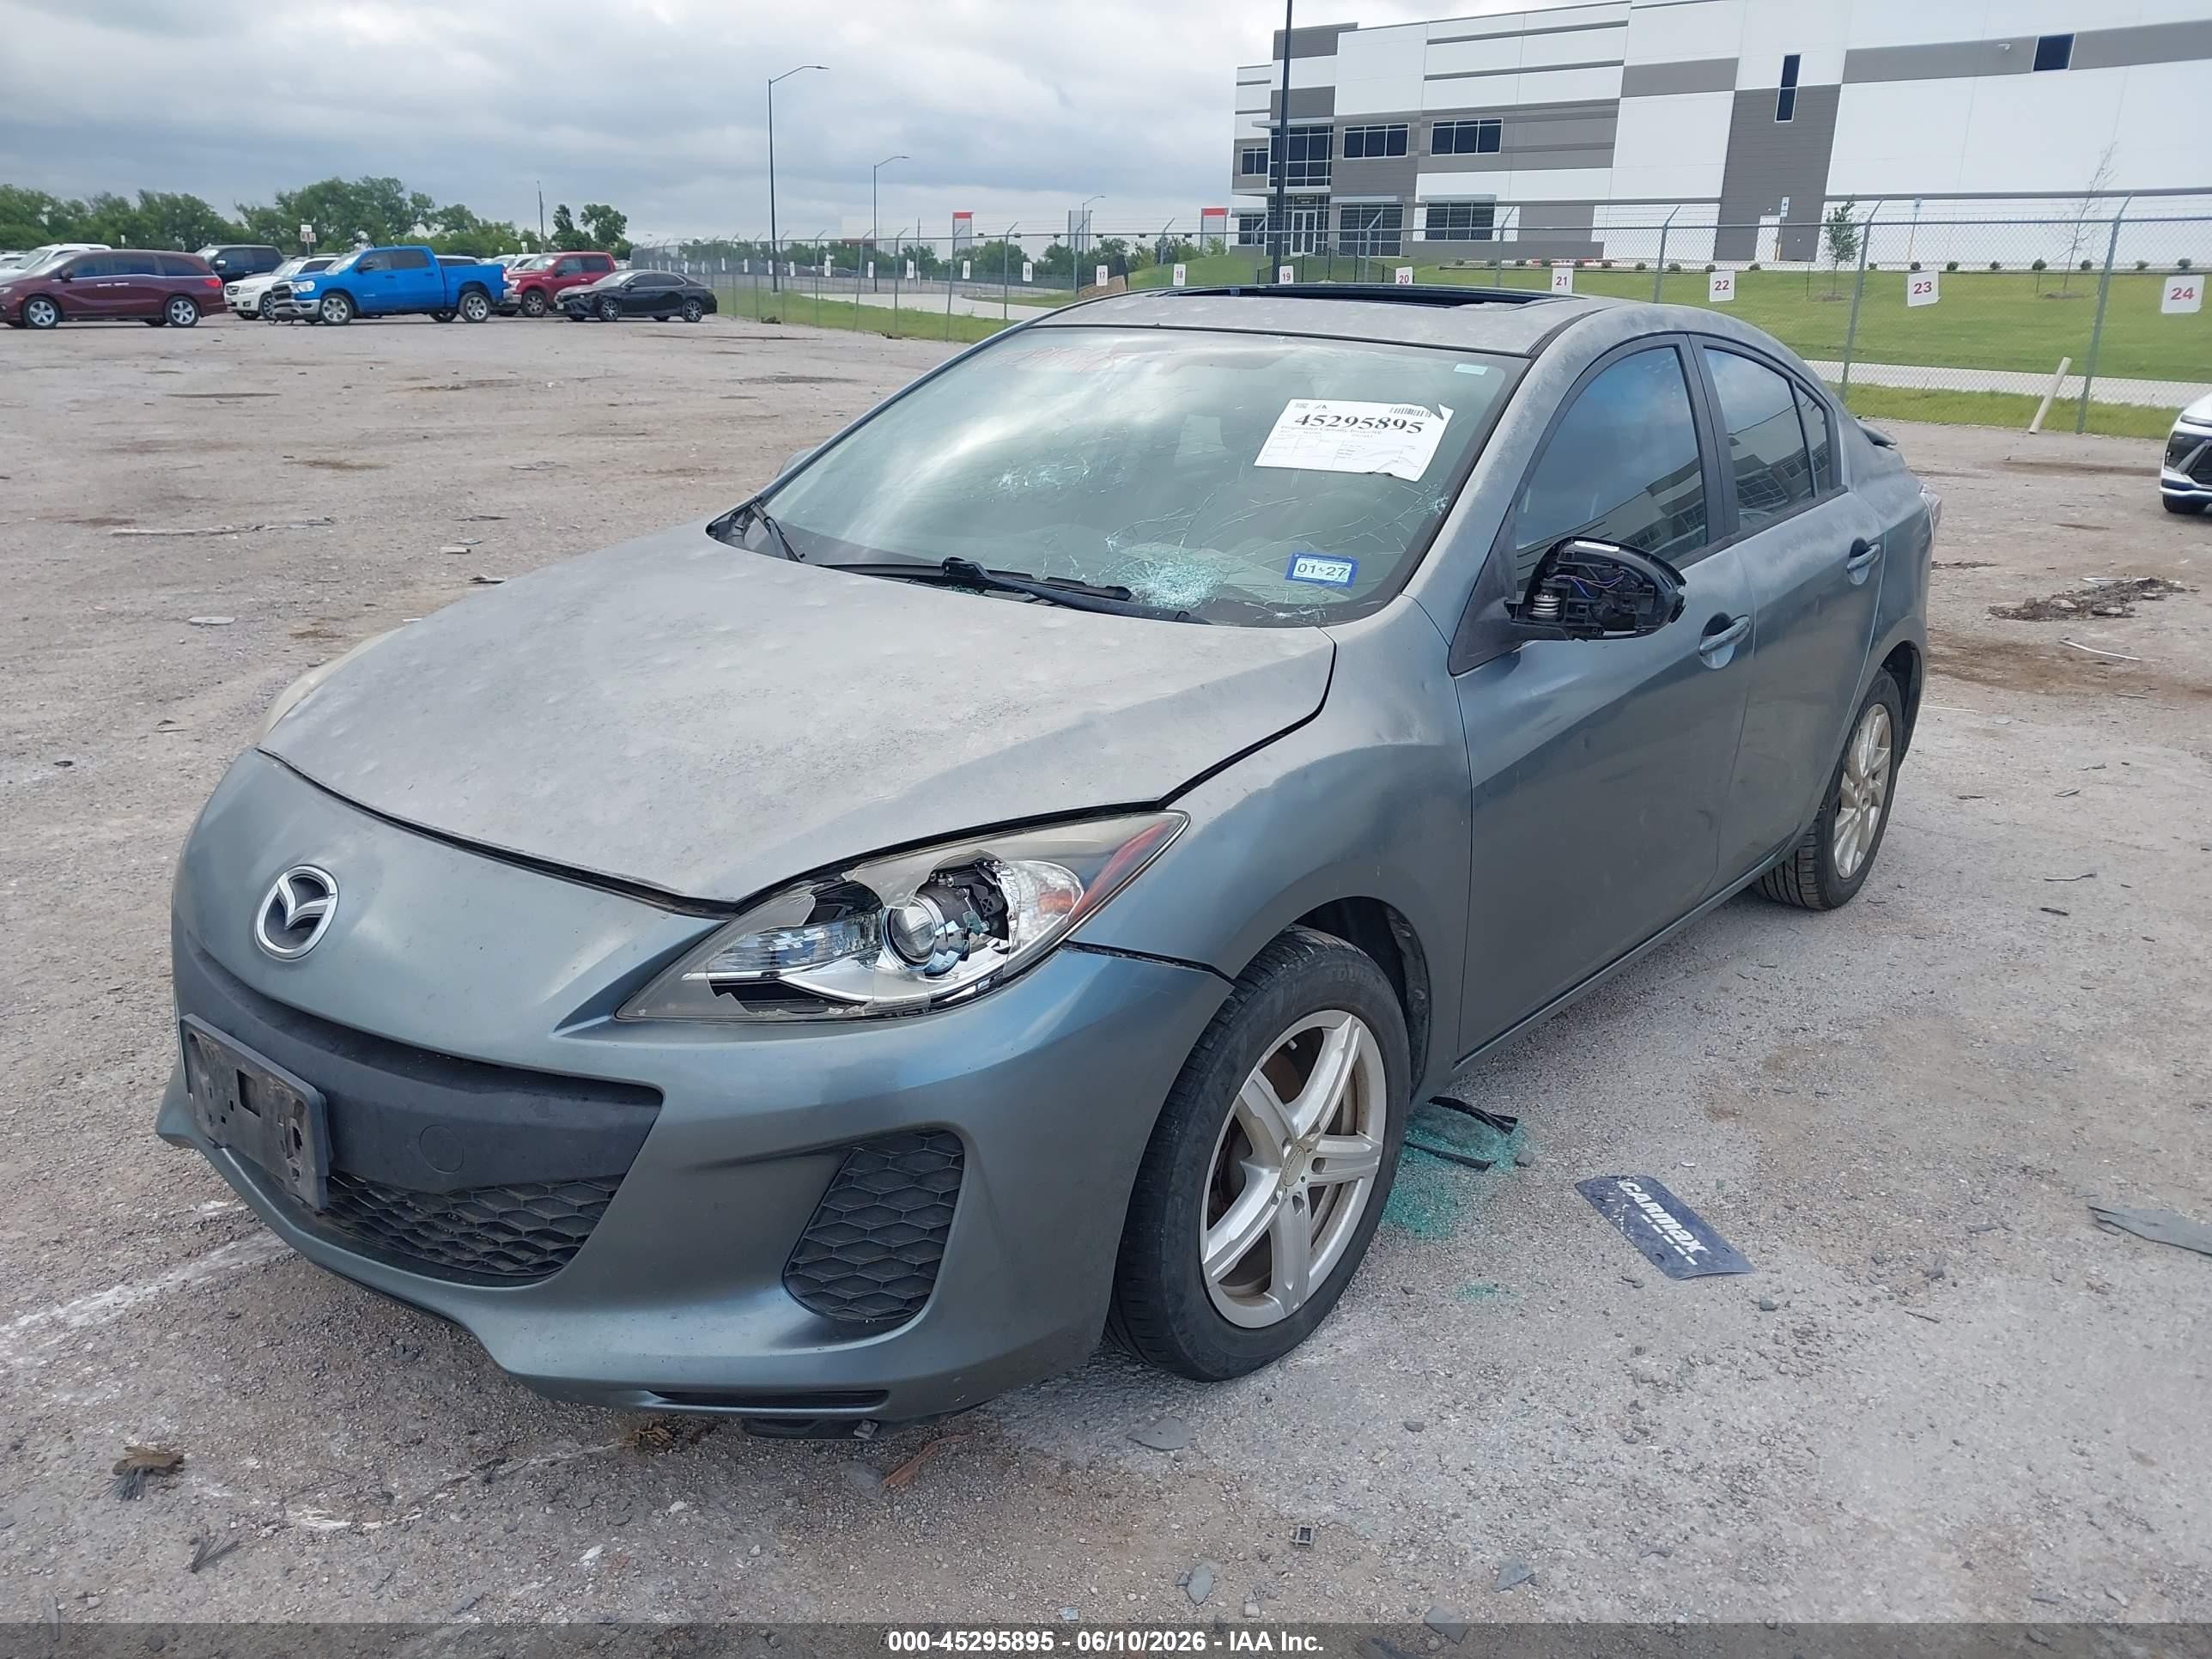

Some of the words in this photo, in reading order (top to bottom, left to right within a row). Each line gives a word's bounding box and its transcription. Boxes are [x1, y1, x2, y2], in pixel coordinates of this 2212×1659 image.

[1281, 271, 1291, 282] 19
[1399, 274, 1410, 284] 20
[1555, 276, 1568, 286] 21
[1714, 279, 1729, 291] 22
[1913, 281, 1932, 295] 23
[2170, 287, 2195, 301] 24
[1294, 413, 1425, 434] 45295895
[1297, 562, 1316, 574] 01
[1325, 566, 1348, 577] 27
